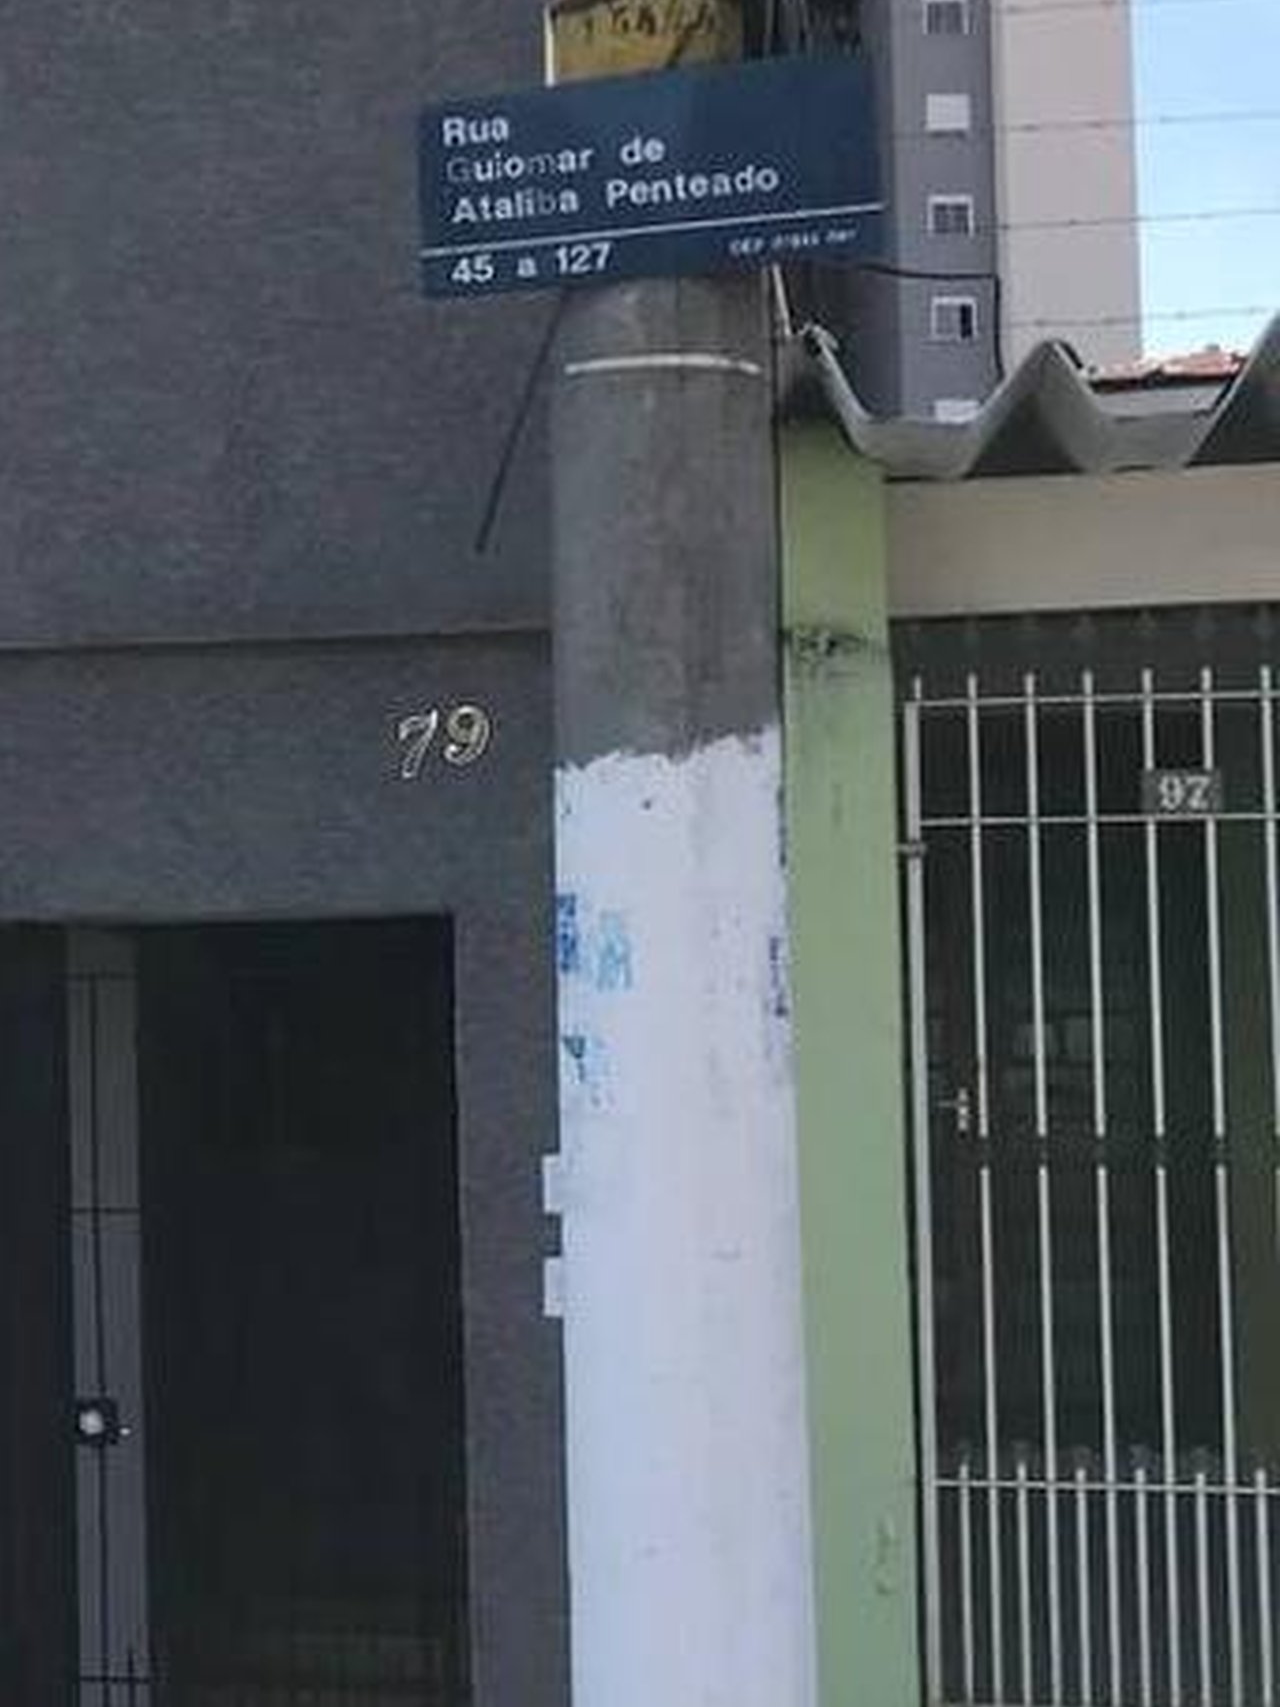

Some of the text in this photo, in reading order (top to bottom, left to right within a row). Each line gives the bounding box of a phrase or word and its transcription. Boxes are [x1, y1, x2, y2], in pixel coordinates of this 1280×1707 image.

[442, 116, 509, 146] Rua
[620, 136, 666, 164] de
[606, 163, 780, 208] Penteado
[451, 243, 611, 284] 45 a 127
[399, 705, 489, 778] 79
[1160, 775, 1210, 810] 97
